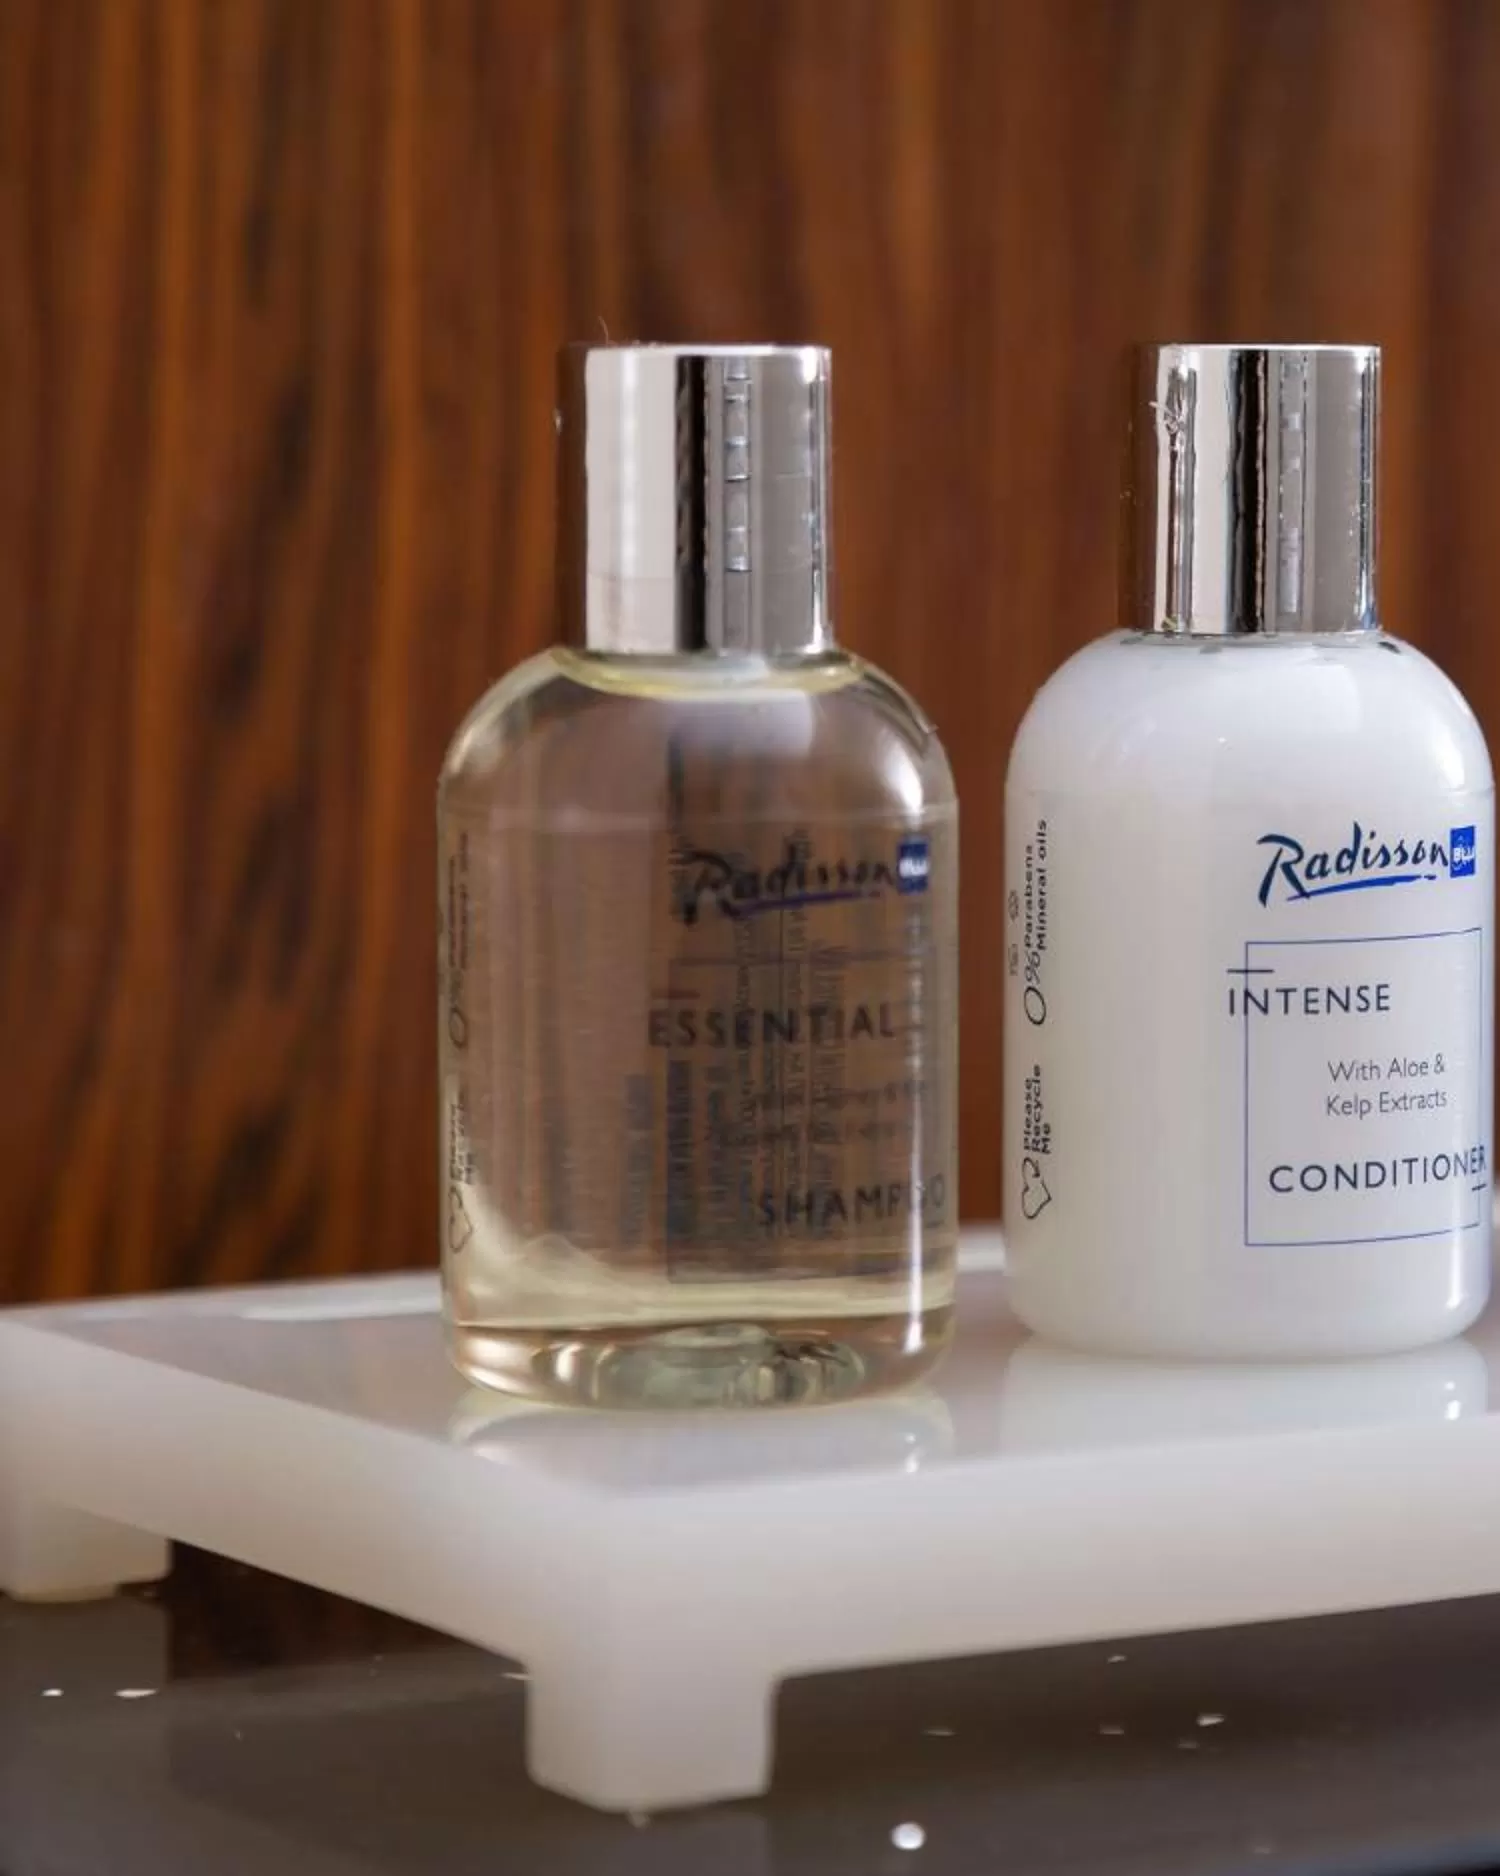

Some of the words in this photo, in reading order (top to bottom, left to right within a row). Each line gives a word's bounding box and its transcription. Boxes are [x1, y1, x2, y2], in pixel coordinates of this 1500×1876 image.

[1036, 819, 1047, 860] oils
[1256, 820, 1449, 908] Radisson
[1036, 868, 1047, 950] Mineral
[1228, 984, 1392, 1018] INTENSE
[649, 1003, 895, 1048] ESSENTIAL
[1327, 1059, 1381, 1083] With
[1387, 1057, 1429, 1081] Aloe
[1433, 1052, 1446, 1075] &
[1023, 1077, 1033, 1151] Please
[1031, 1064, 1043, 1153] Recycle
[1325, 1094, 1372, 1121] Kelp
[1378, 1091, 1449, 1114] Extracts
[1041, 1123, 1052, 1155] Me
[1268, 1145, 1488, 1194] CONDITIONER
[759, 1174, 946, 1227] SHAMPO
